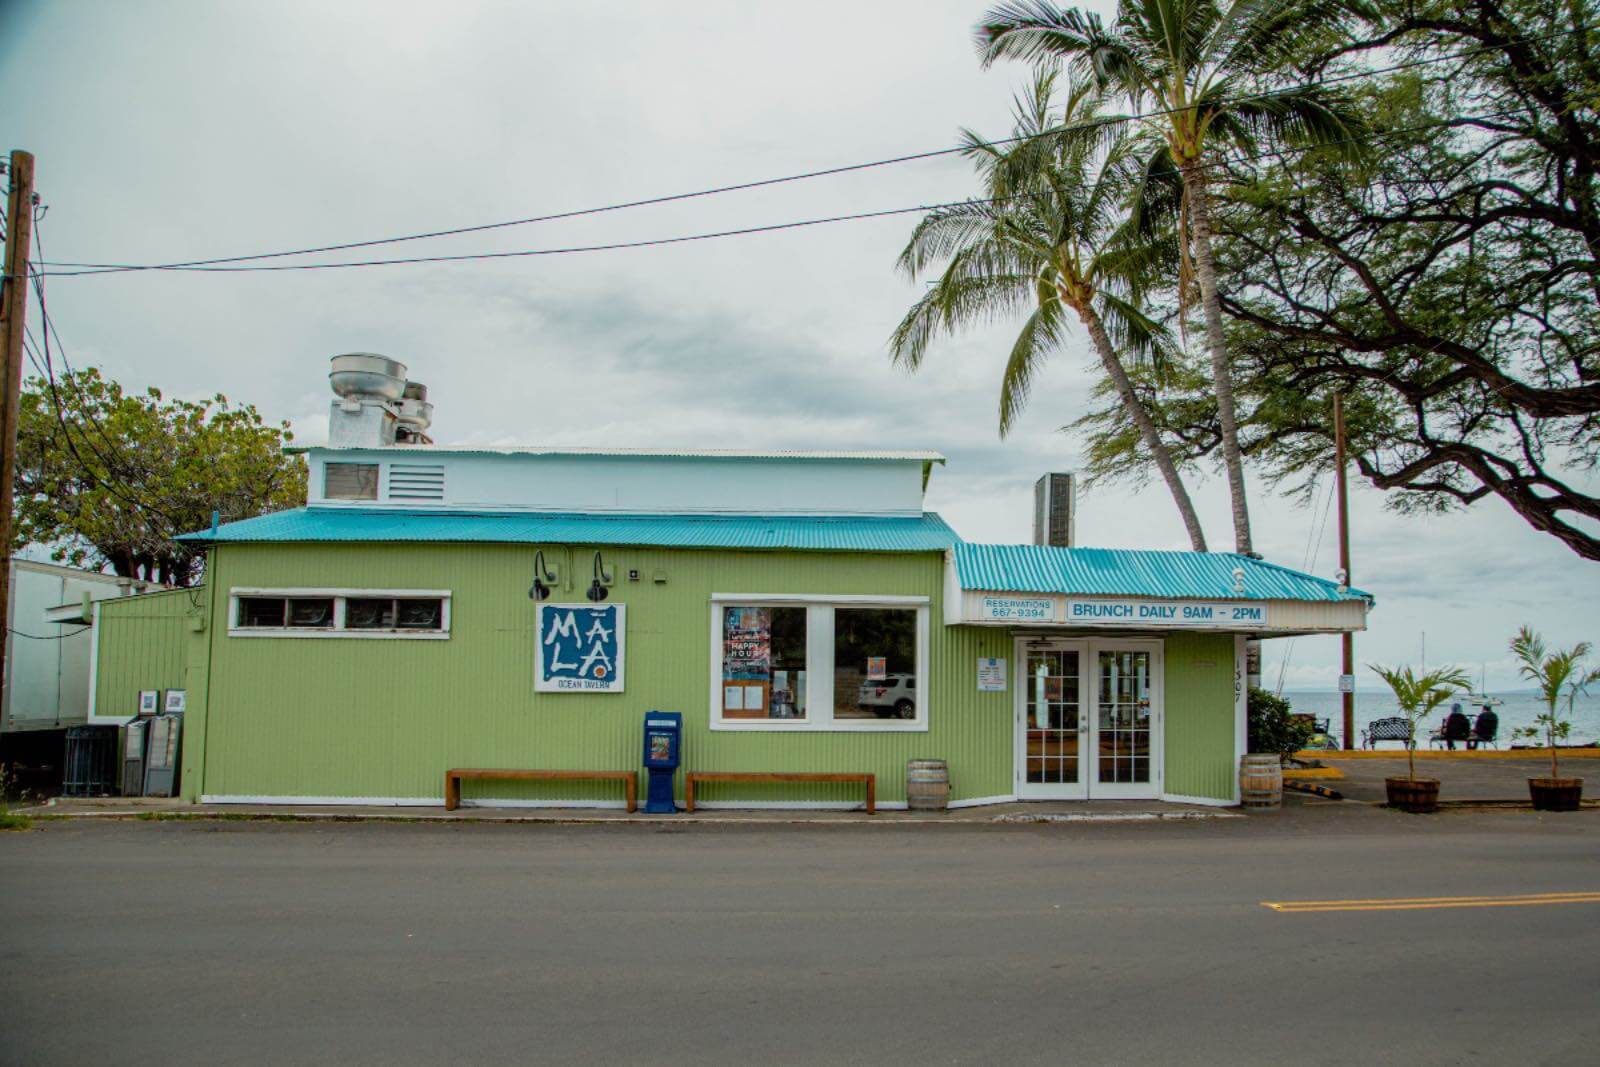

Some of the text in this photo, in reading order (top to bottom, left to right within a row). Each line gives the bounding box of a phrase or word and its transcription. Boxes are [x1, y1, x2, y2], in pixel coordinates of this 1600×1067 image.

[986, 600, 1050, 609] RESERVATIONS
[992, 608, 1045, 617] 667-9394
[1073, 603, 1133, 617] BRUNCH
[1139, 605, 1177, 618] DAILY
[1183, 606, 1213, 619] 9AM
[1232, 607, 1261, 620] 2PM
[731, 642, 760, 650] HAPPY
[559, 680, 610, 689] OCEAN TAVERN
